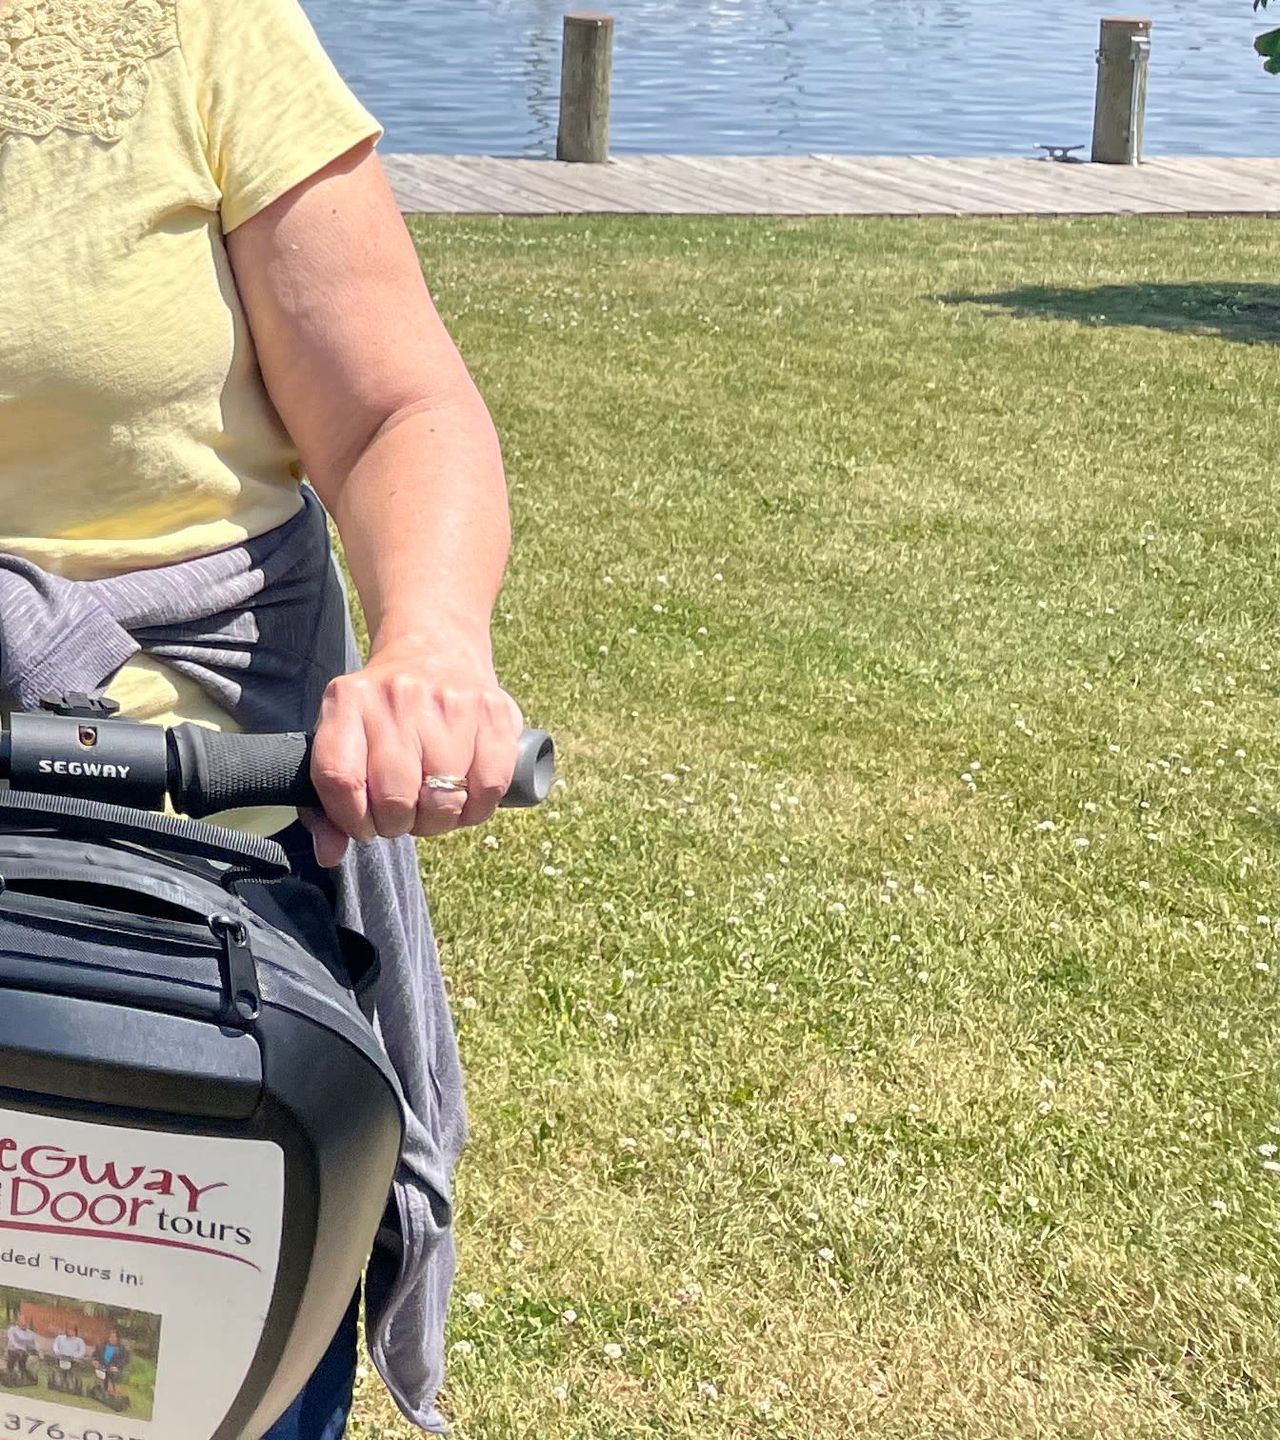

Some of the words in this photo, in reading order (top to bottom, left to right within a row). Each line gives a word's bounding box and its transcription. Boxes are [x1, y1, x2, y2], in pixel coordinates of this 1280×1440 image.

[39, 760, 130, 779] SEGWAY
[10, 1177, 153, 1226] Door
[158, 1208, 252, 1246] tours
[52, 1256, 111, 1281] Tours
[120, 1270, 143, 1287] in:
